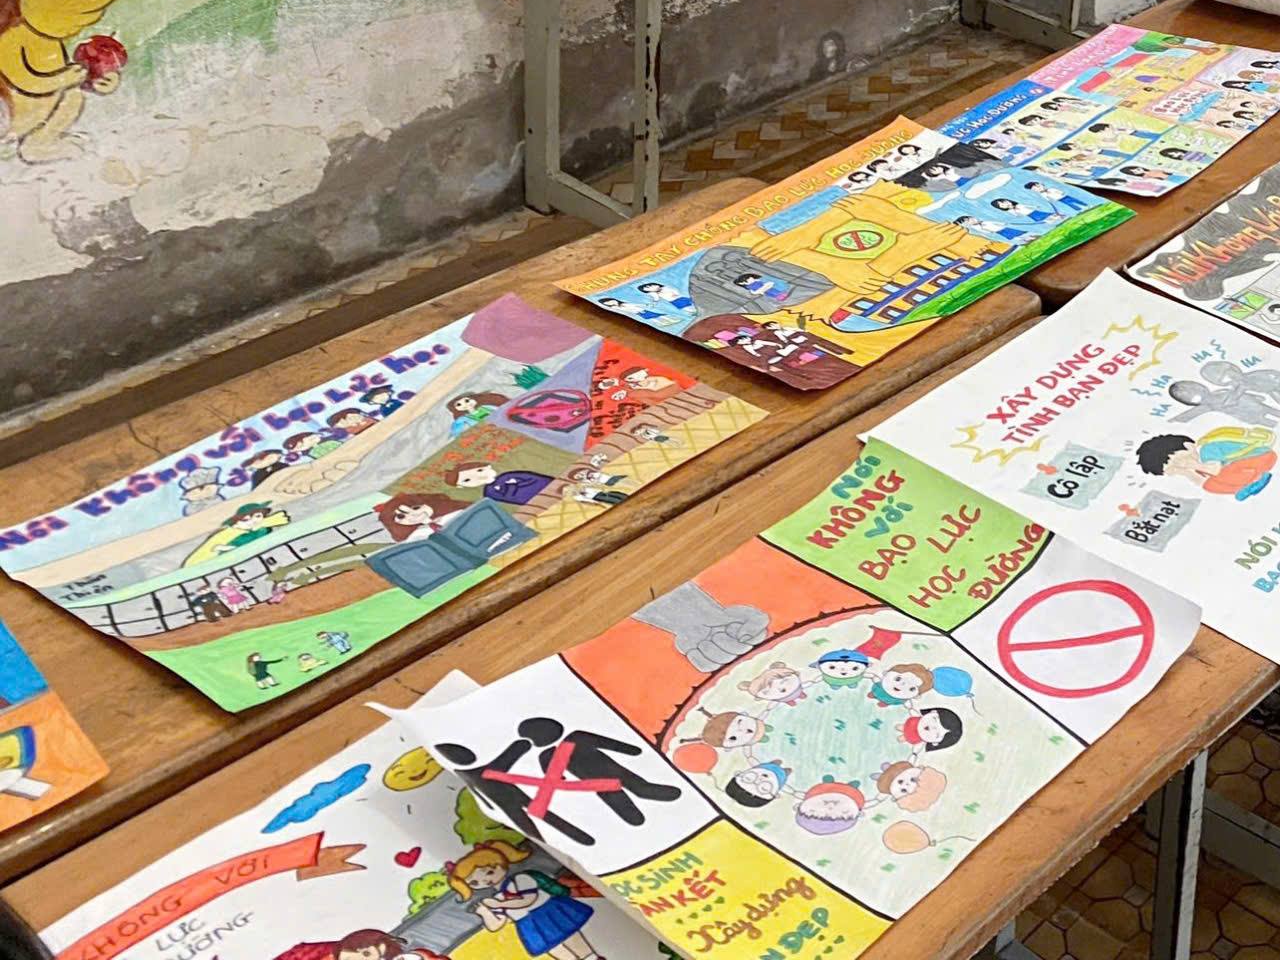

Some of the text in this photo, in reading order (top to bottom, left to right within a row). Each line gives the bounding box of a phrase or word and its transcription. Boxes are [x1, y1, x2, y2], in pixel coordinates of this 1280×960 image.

[986, 343, 1105, 425] XÂY DỰNG
[1002, 344, 1141, 445] TÌNH BẠN ĐẸP
[807, 470, 906, 549] KHÔNG
[858, 505, 981, 581] BẠO LỰC
[908, 565, 967, 608] HỌC
[1235, 536, 1278, 570] NÓI
